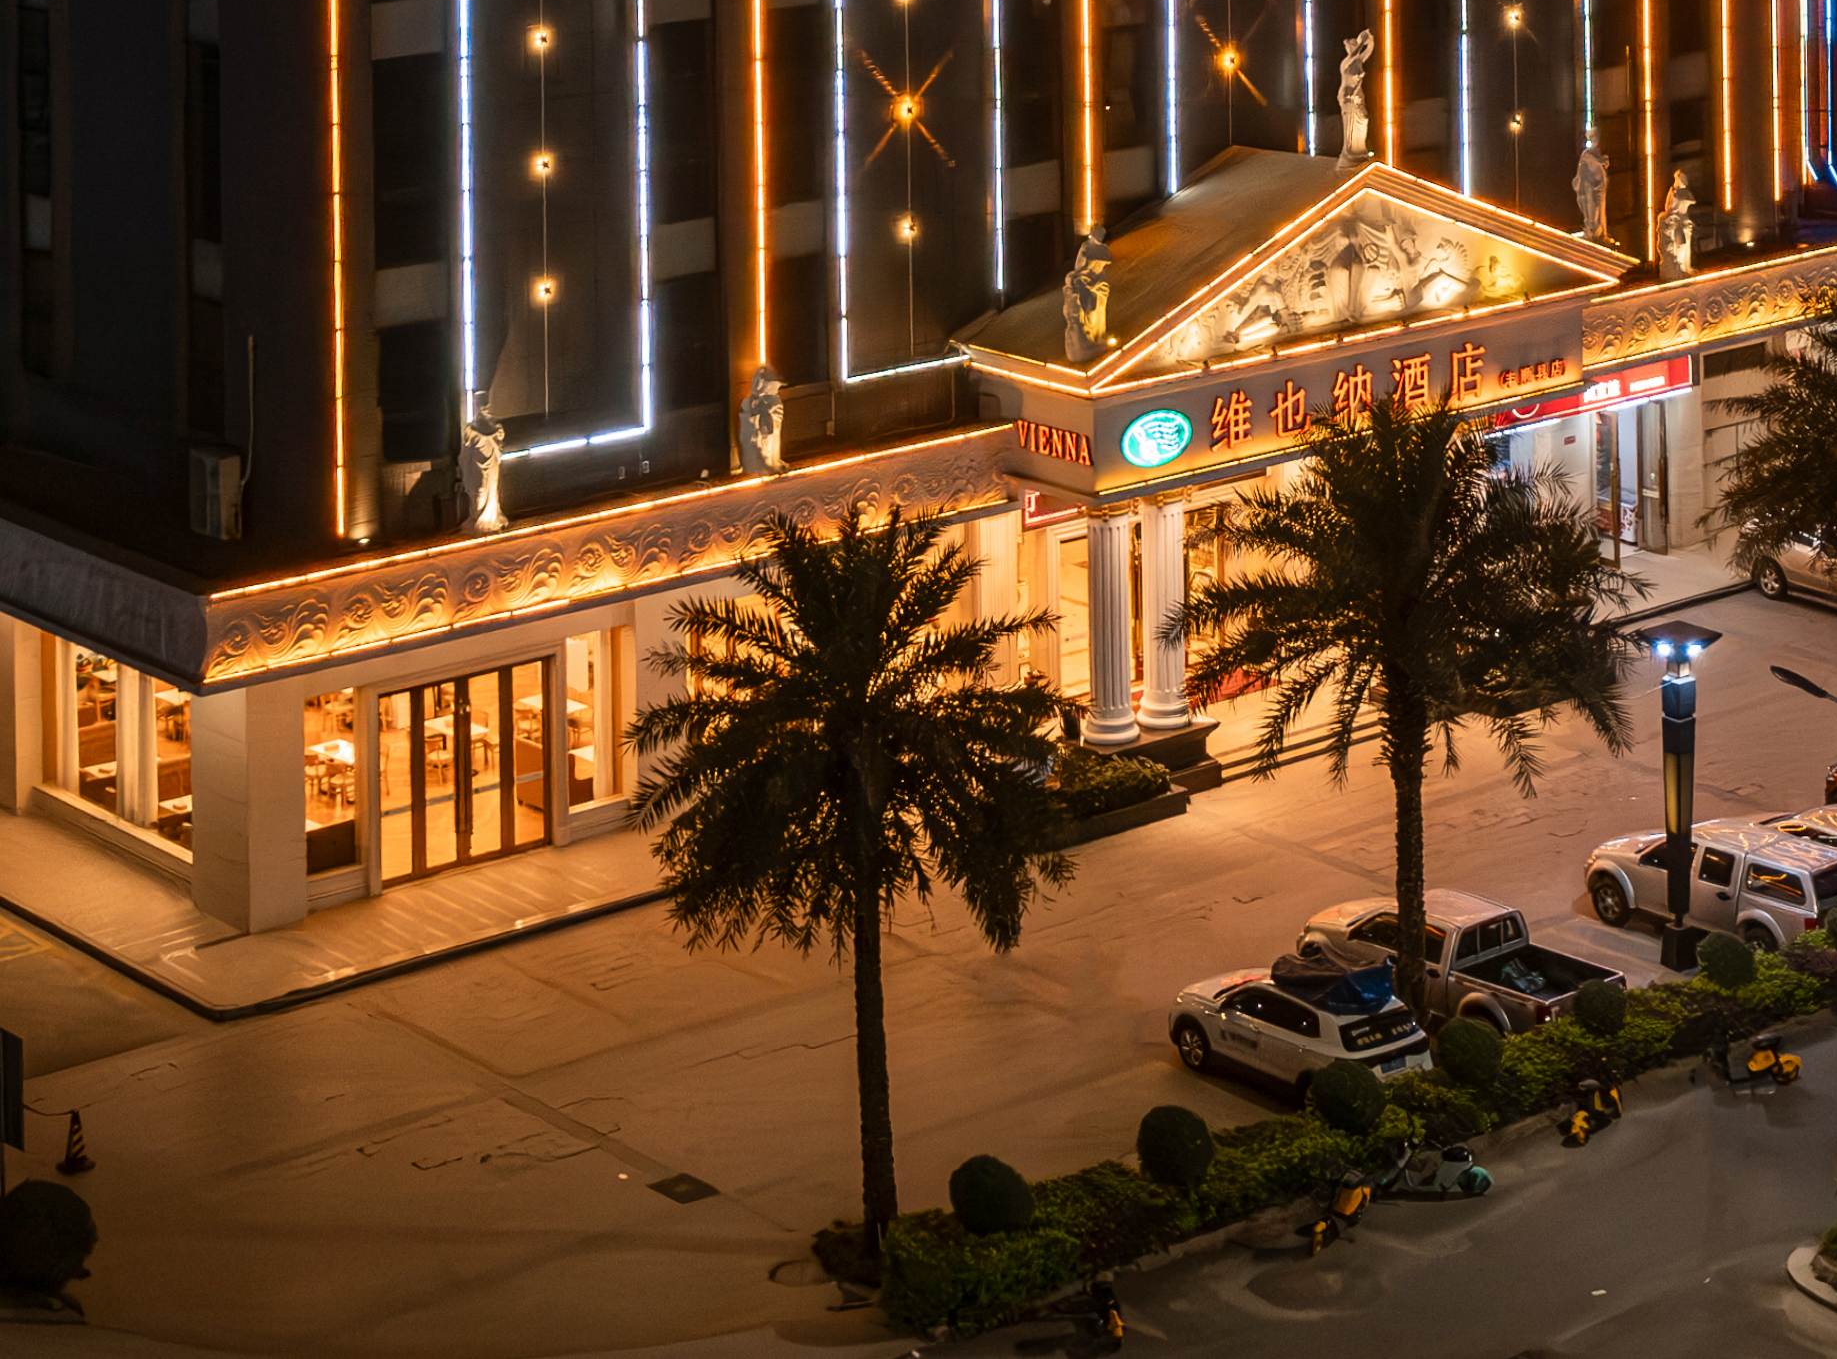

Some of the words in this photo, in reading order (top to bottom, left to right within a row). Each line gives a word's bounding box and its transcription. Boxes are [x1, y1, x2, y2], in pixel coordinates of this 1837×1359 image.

[1210, 342, 1487, 453] 维也纳酒店
[1017, 419, 1092, 467] VIENNA
